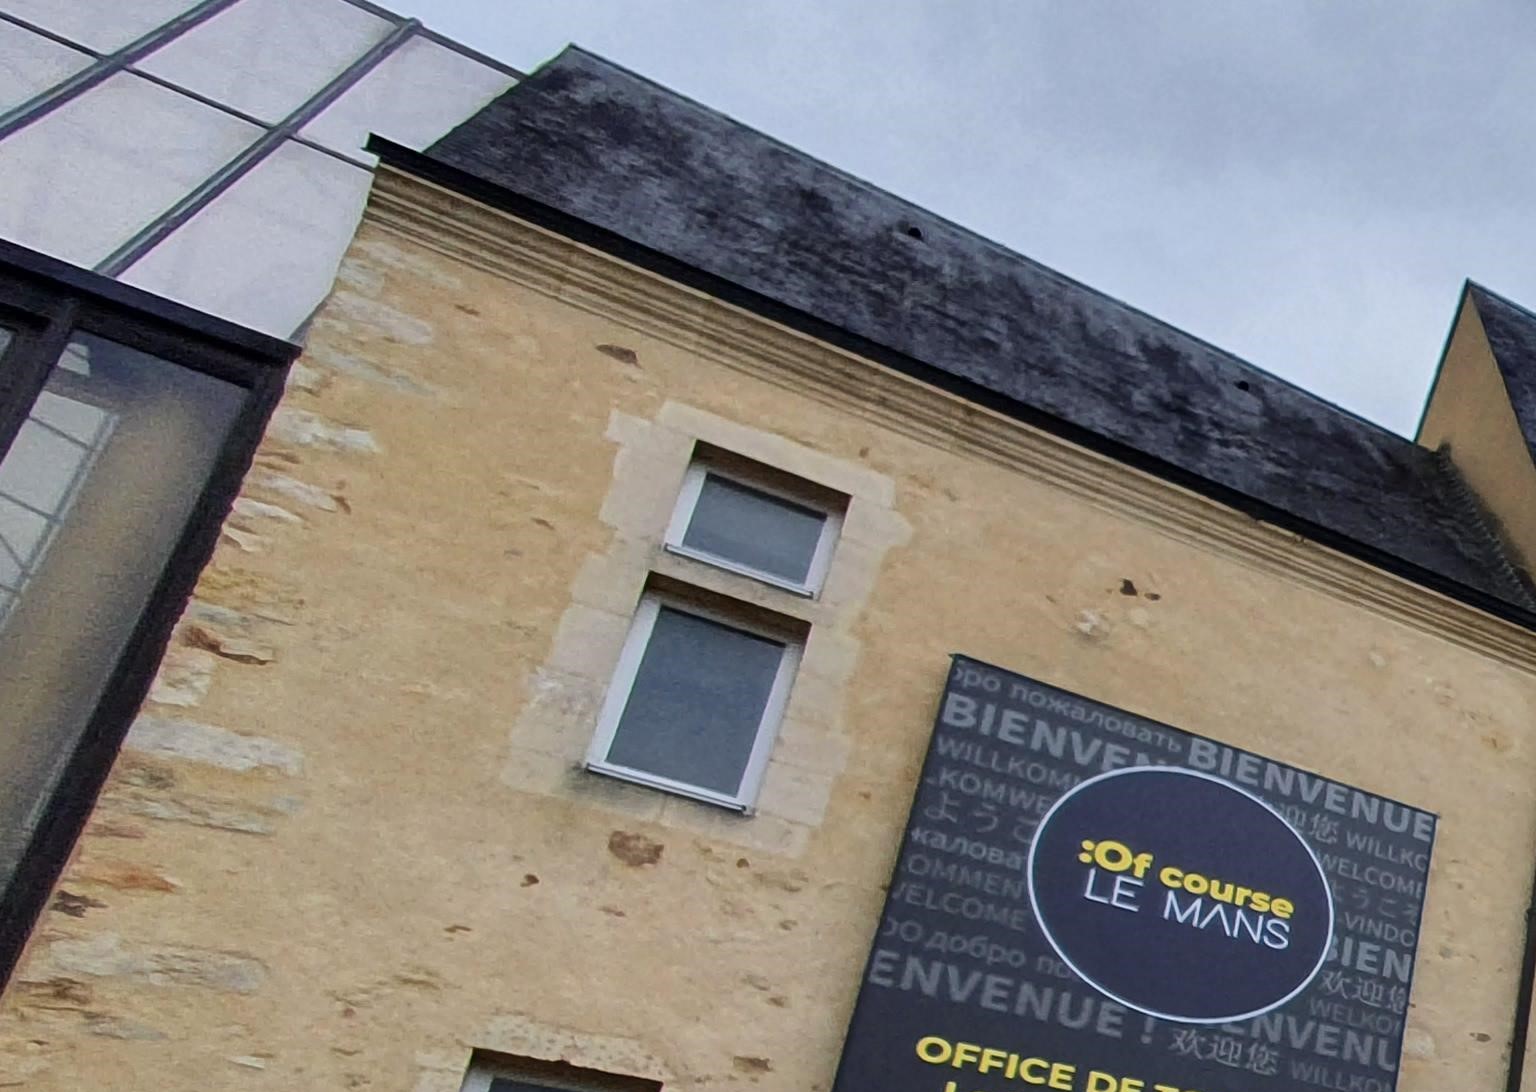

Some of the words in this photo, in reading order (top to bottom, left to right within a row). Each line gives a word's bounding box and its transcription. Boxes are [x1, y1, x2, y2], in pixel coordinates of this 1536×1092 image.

[943, 692, 1166, 771] BIENVE
[937, 733, 1082, 790] WILLKOM
[1009, 683, 1182, 752] пожаловать
[1188, 737, 1434, 842] BIENVENUE
[1084, 867, 1144, 912] LE
[1163, 889, 1290, 950] MANS
[1159, 865, 1294, 919] course
[925, 931, 1026, 968] добро
[869, 949, 1127, 1039] ENVENUE
[1167, 1026, 1280, 1076] 欢迎您
[1309, 996, 1400, 1037] WELKO
[916, 1036, 1076, 1091] OFFICE
